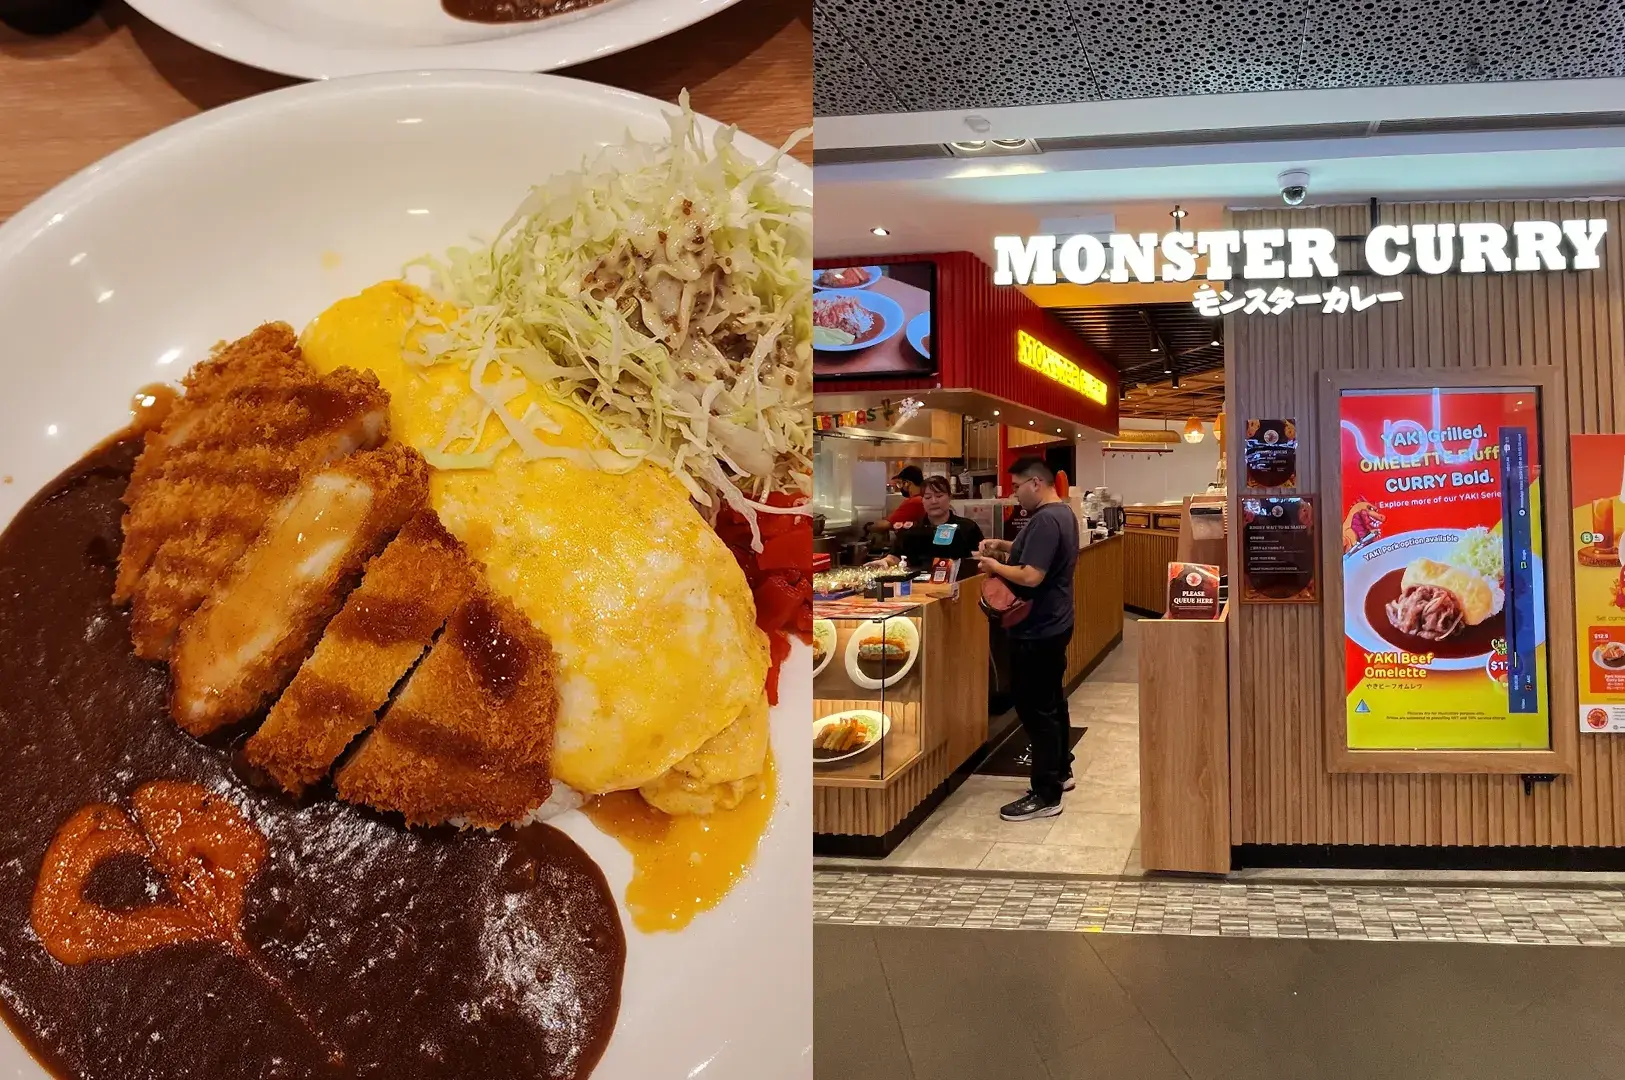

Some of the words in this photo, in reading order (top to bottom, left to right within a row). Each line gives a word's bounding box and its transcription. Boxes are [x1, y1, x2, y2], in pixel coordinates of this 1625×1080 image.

[994, 228, 1338, 286] MONSTER
[1364, 218, 1608, 276] CURRY
[1192, 286, 1404, 317] モンスターカレー
[1381, 431, 1423, 447] YAKI
[1428, 424, 1488, 442] Grilled.
[1385, 473, 1447, 493] CURRY
[1452, 469, 1495, 487] Bold.
[1379, 500, 1409, 509] Explore
[1411, 498, 1431, 506] more
[1433, 496, 1442, 504] of
[1459, 493, 1479, 501] YAKI
[1363, 548, 1381, 561] YAKI
[1382, 542, 1400, 554] Pork
[1400, 537, 1424, 548] option
[1425, 534, 1459, 543] available
[1363, 652, 1398, 664] YAKI
[1401, 652, 1434, 664] Beef
[1364, 666, 1427, 678] Omelette
